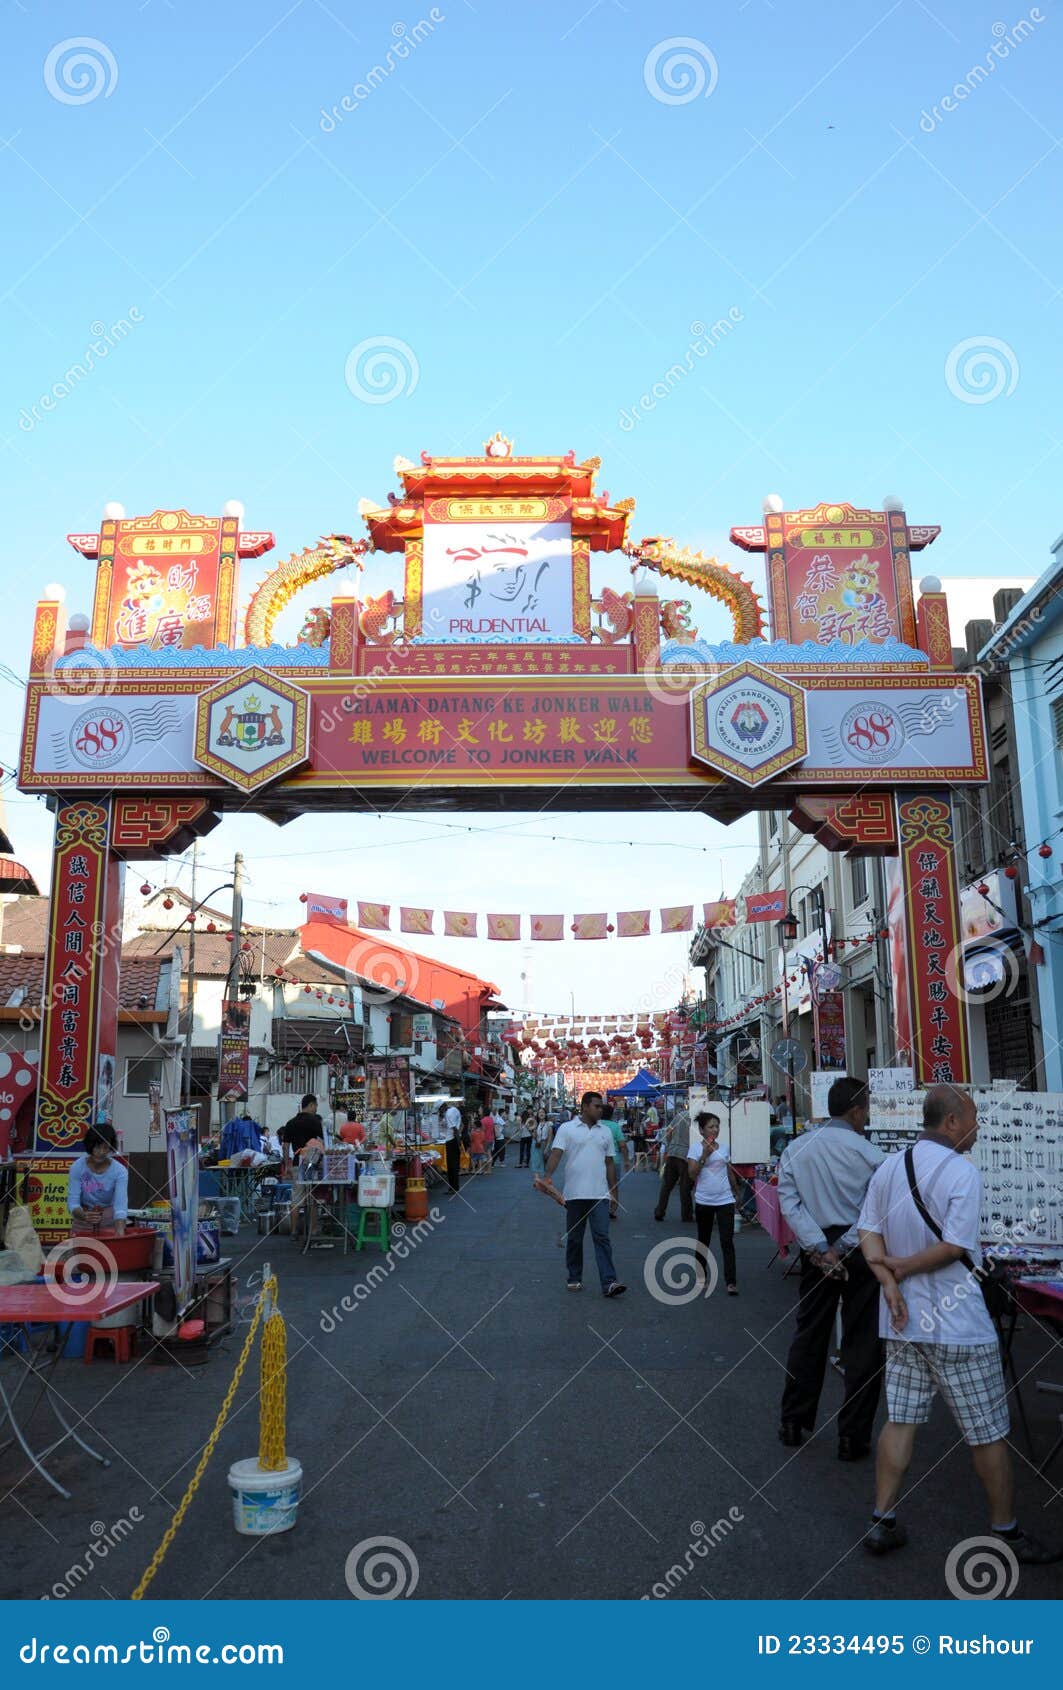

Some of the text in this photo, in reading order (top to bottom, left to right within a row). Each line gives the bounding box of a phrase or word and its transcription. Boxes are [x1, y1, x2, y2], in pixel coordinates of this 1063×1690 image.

[449, 618, 551, 632] PRUDENTIAL
[428, 697, 496, 713] DATANG
[503, 697, 525, 713] KE
[531, 697, 599, 713] JONKER
[608, 697, 655, 713] WALK
[718, 691, 780, 717] MAJLIS BANDARAYA
[75, 717, 123, 756] 88
[848, 712, 893, 751] 88
[361, 748, 639, 765] WELCOME TO JONKER WALK
[56, 855, 89, 1088] 誠信人間人同富貴春
